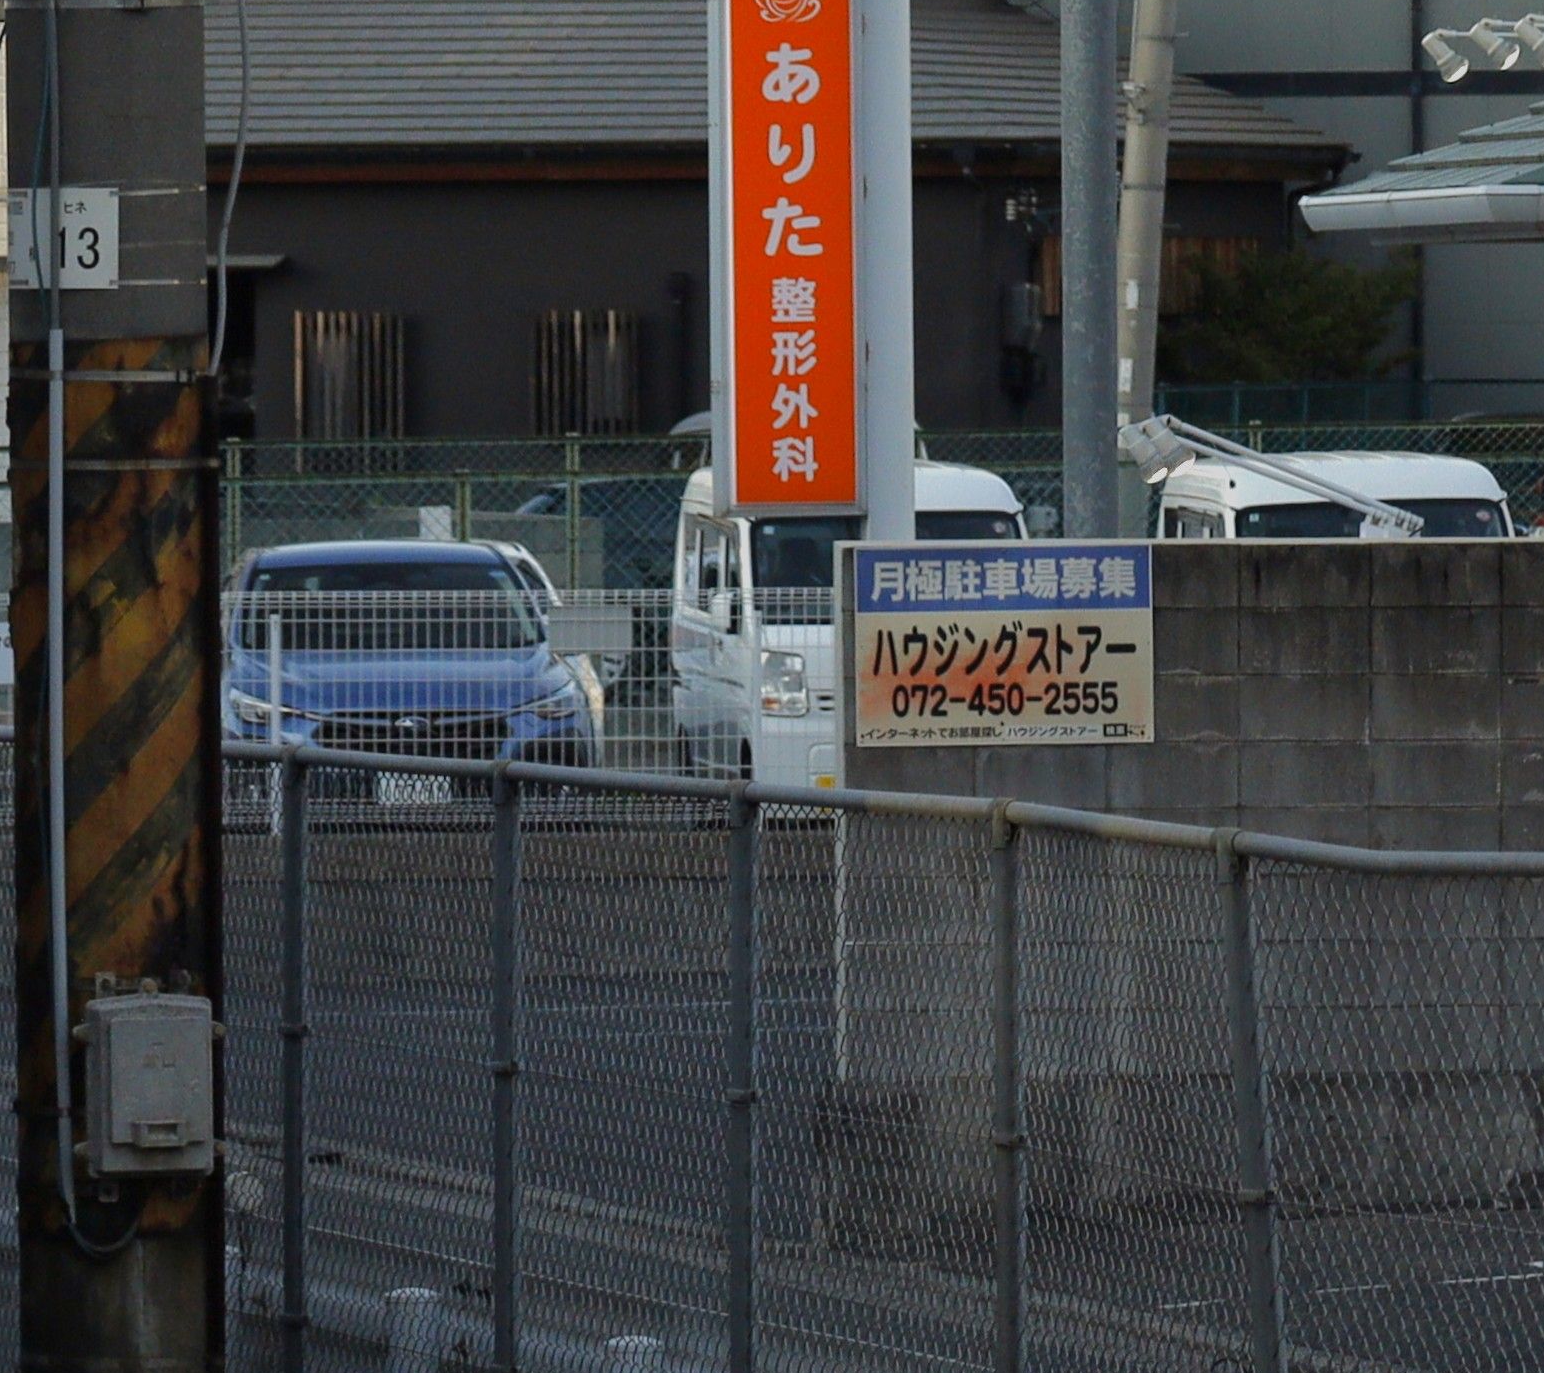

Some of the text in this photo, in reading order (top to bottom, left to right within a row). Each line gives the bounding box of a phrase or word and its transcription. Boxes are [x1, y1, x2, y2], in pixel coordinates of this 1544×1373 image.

[63, 201, 88, 215] ヒネ
[871, 556, 1136, 603] 月極駐車場募集
[872, 620, 1137, 677] ハウジングストアー
[891, 682, 1119, 718] 072-450-2555
